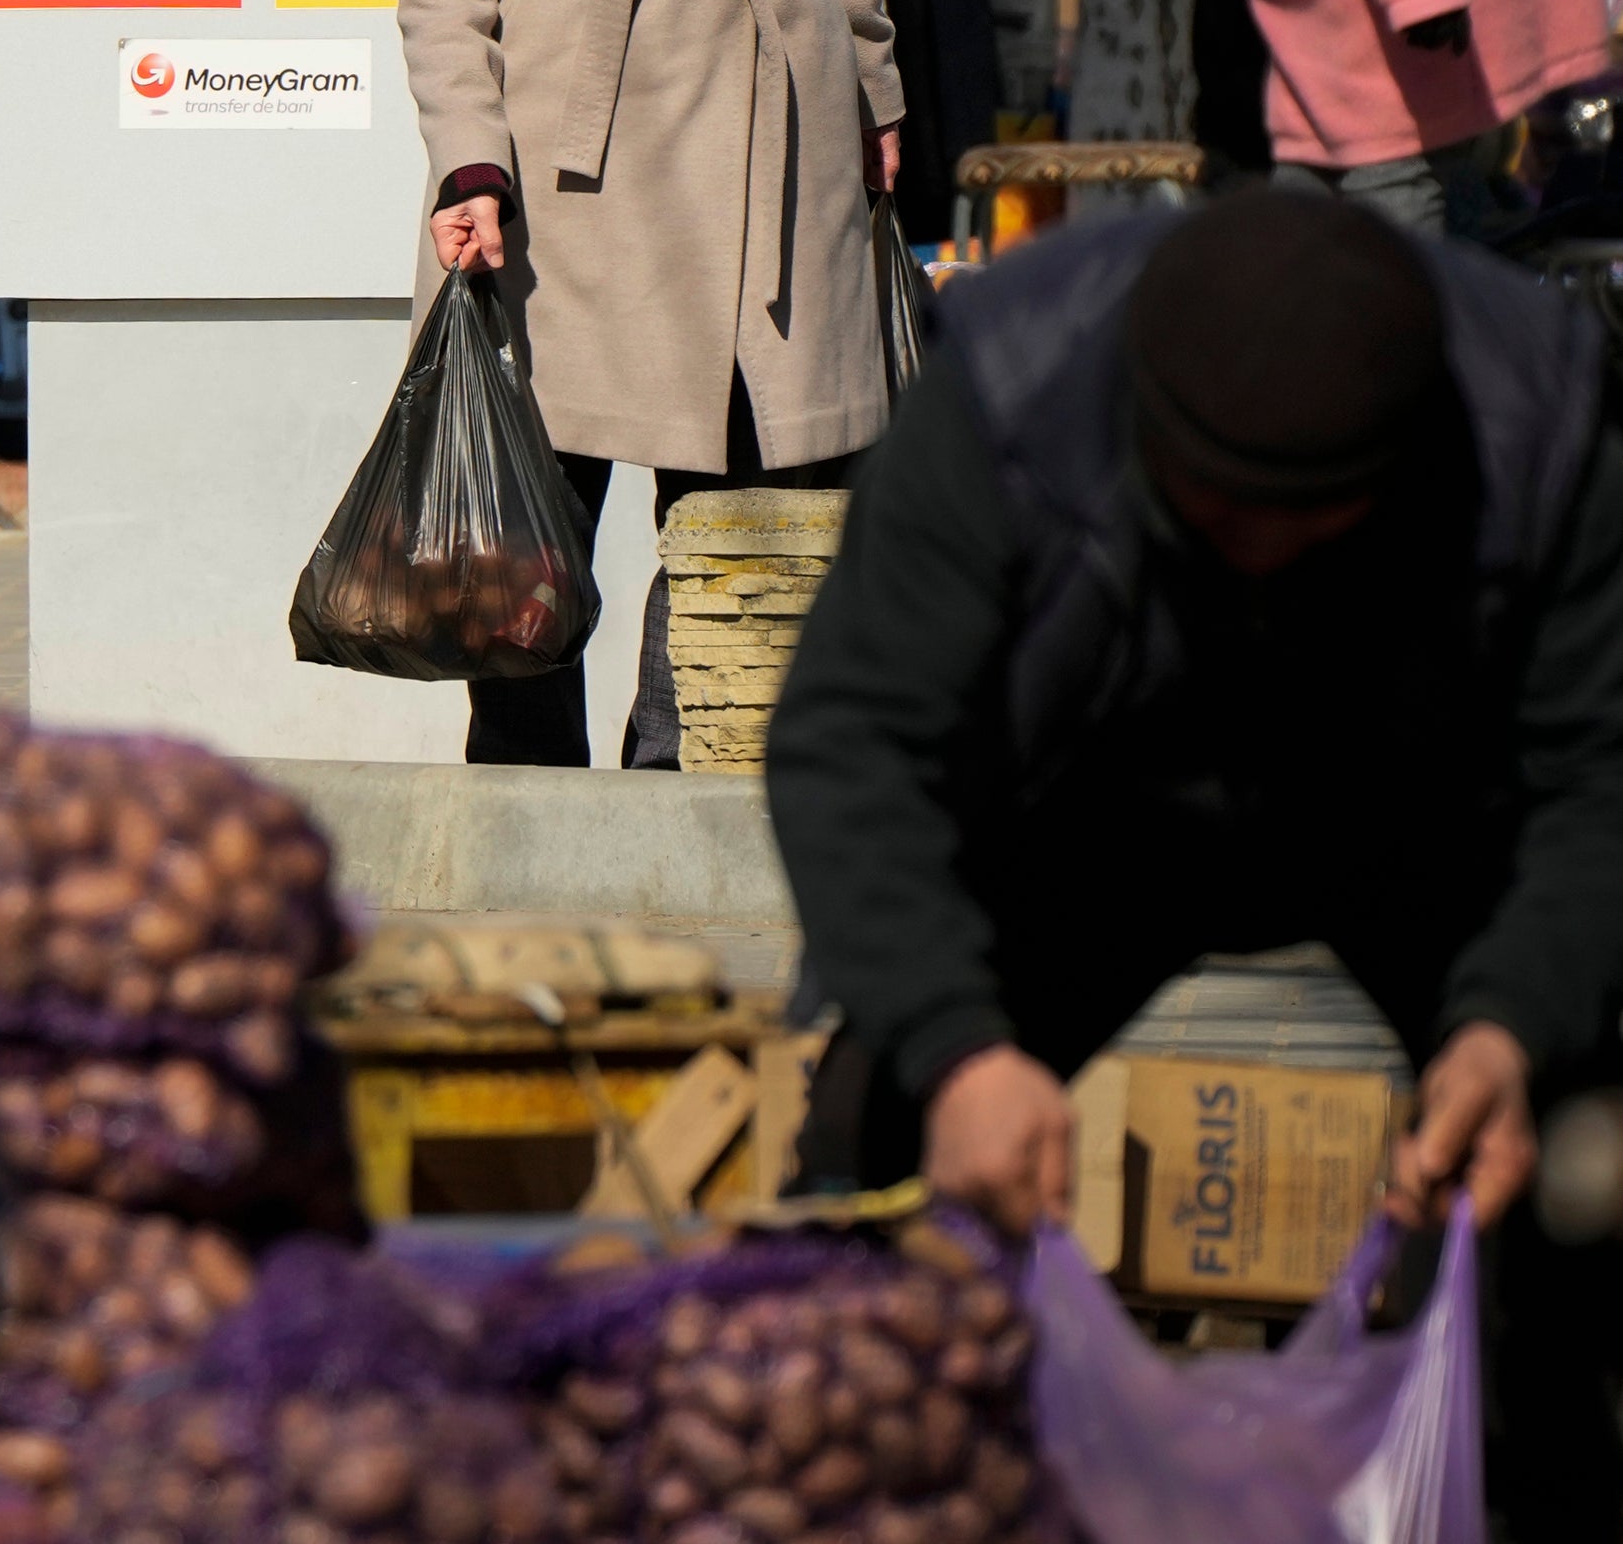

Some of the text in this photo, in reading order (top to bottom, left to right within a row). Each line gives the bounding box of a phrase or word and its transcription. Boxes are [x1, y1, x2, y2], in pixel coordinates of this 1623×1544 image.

[185, 68, 359, 98] MoneyGram
[185, 99, 313, 114] transfer de bani
[1192, 1082, 1238, 1276] FLORIS
